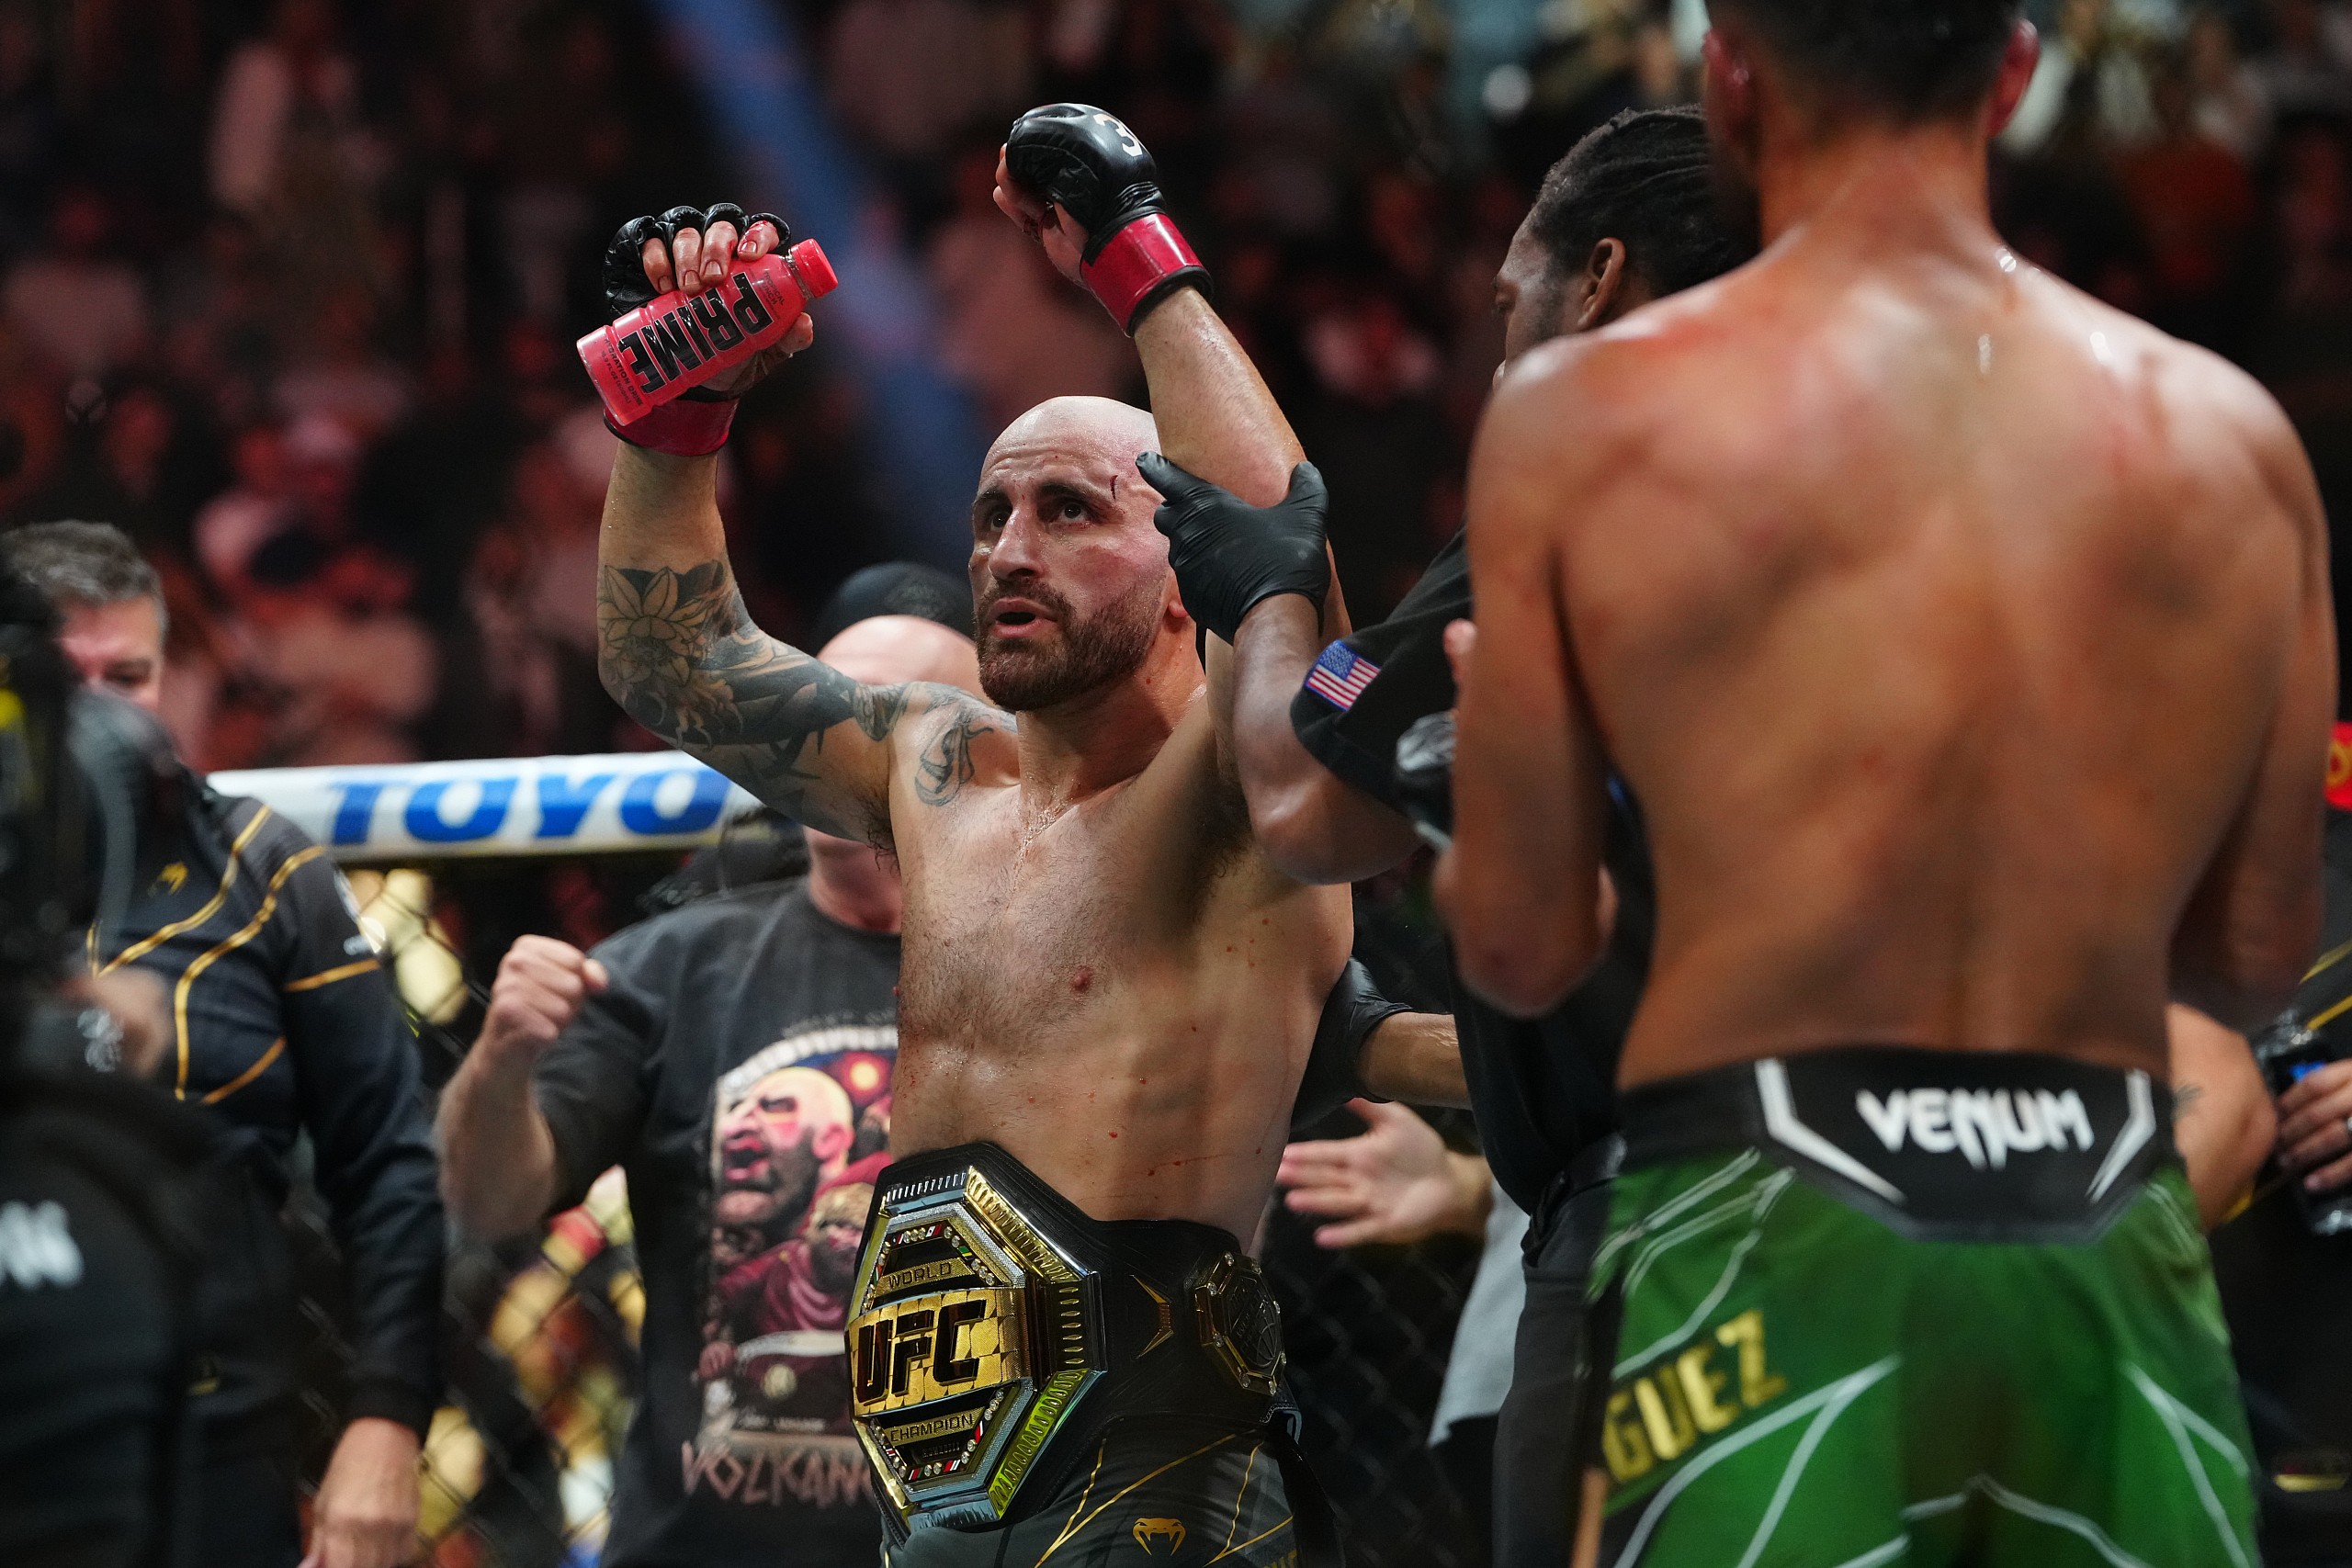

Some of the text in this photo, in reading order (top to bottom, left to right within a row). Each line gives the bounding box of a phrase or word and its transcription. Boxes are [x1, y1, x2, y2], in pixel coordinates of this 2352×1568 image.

[763, 270, 785, 306] TROPICAL
[605, 337, 643, 406] HYDRATION DRINK
[616, 271, 775, 395] PRIME
[329, 766, 734, 845] TOYO
[1855, 1087, 2095, 1172] VENUM
[888, 1262, 952, 1288] WORLD
[856, 1299, 988, 1407] UFC
[890, 1413, 973, 1442] CHAMPION
[1602, 1310, 1787, 1483] GUEZ
